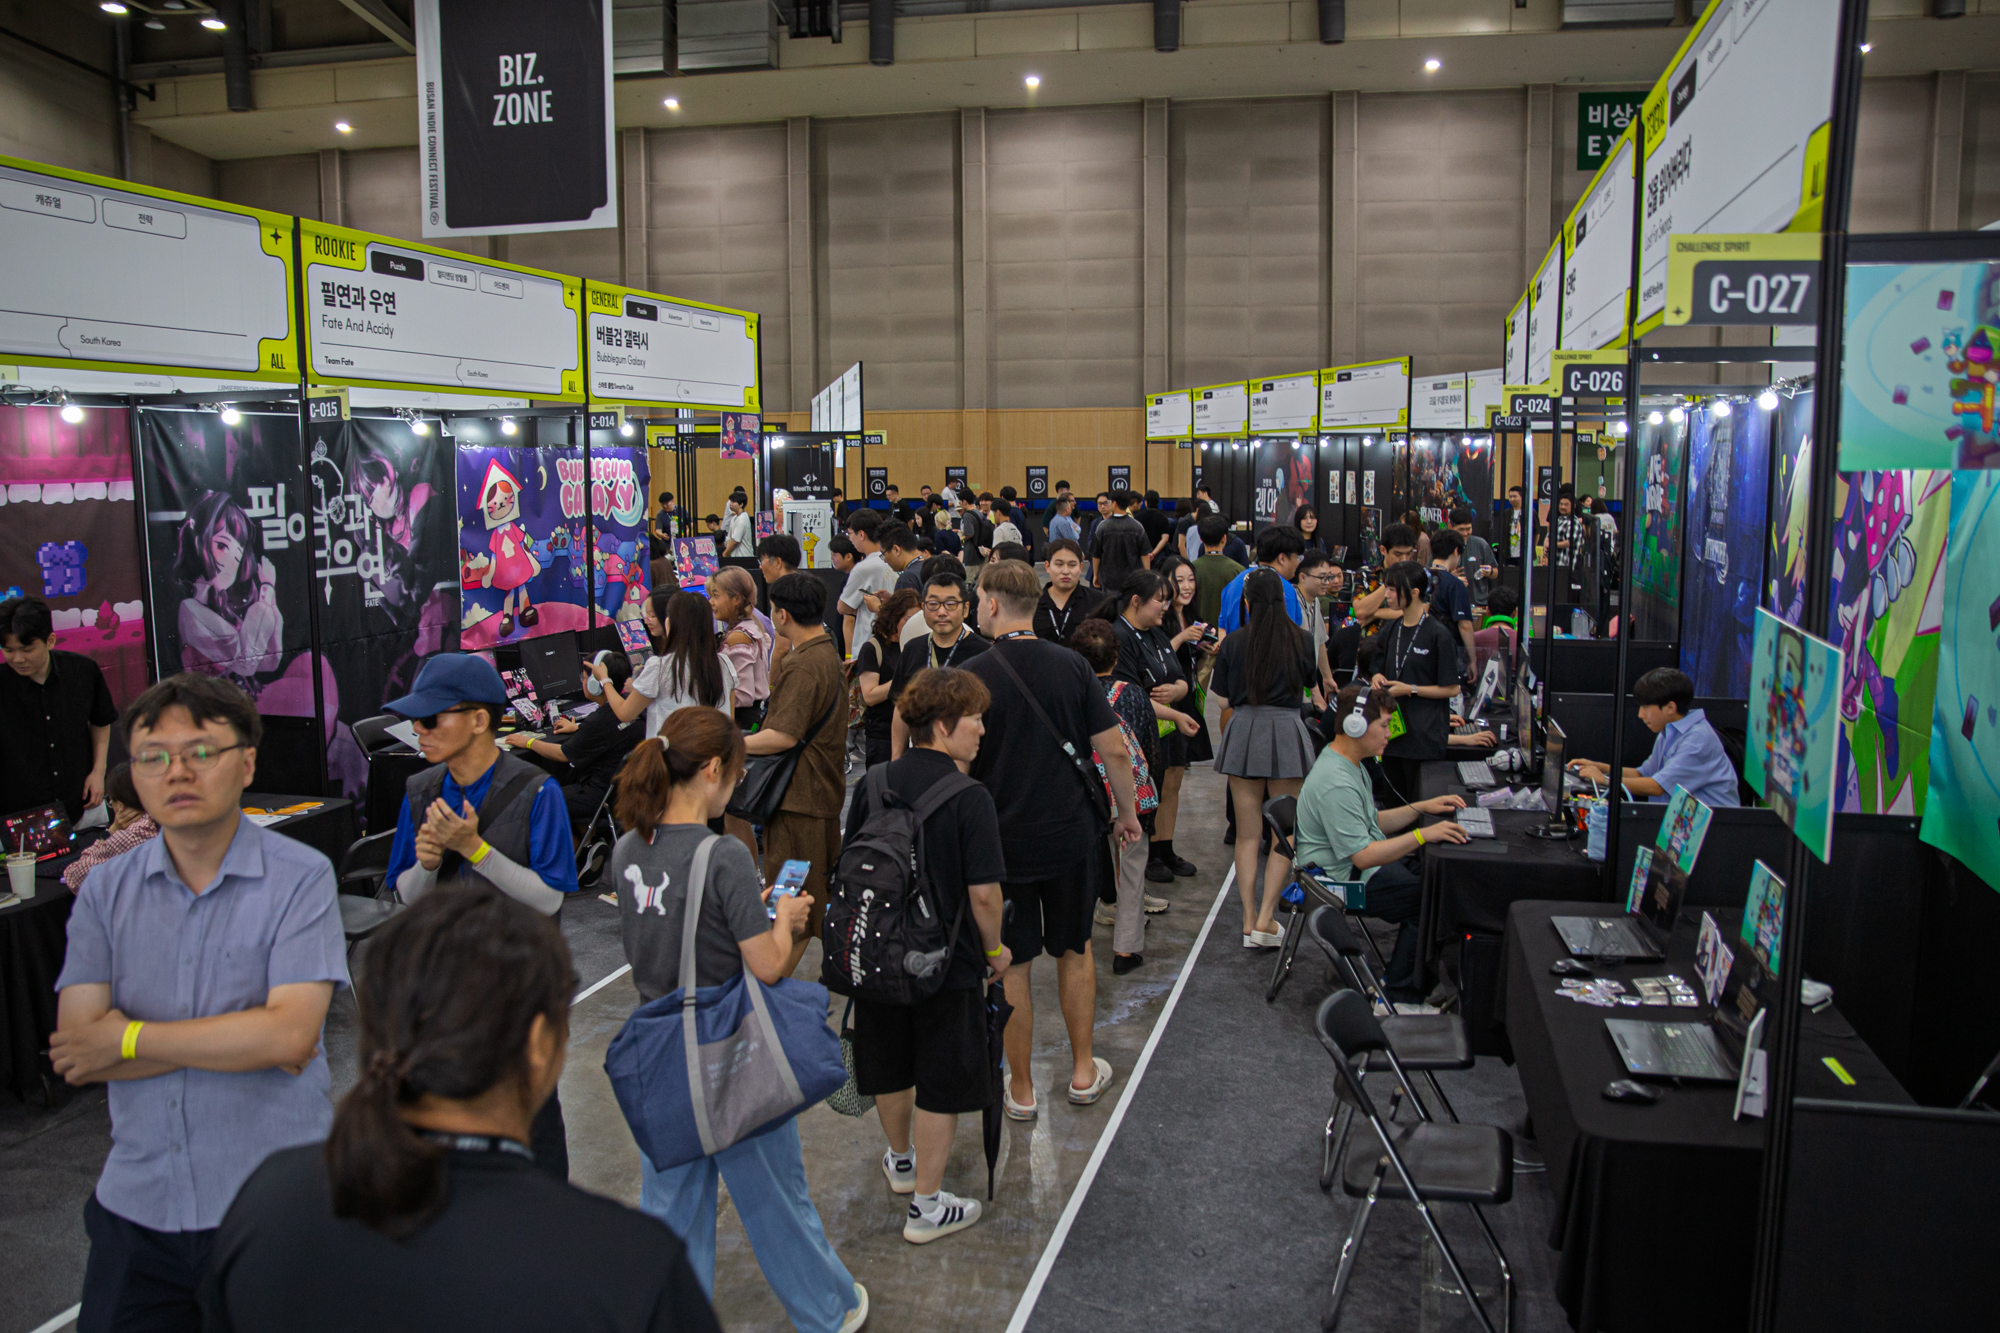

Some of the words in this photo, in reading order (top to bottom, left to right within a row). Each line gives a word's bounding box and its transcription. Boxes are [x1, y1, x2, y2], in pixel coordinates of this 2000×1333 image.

[499, 53, 544, 87] BIZ.
[426, 82, 435, 110] BUSAN
[493, 90, 553, 126] ZONE
[1588, 103, 1642, 128] 비상
[427, 111, 436, 134] INDIE
[428, 136, 438, 172] CONNECT
[429, 174, 439, 210] FESTIVAL
[35, 193, 61, 209] 캐쥬얼
[138, 213, 153, 226] 전략
[315, 235, 356, 261] ROOKIE
[1676, 241, 1722, 253] CHALLENGE
[1723, 240, 1751, 253] SPIRIT
[389, 260, 406, 272] Puzzle
[320, 281, 366, 312] 필연과
[368, 289, 397, 316] 우연
[592, 290, 619, 309] GENERAL
[1709, 273, 1811, 314] C-027
[322, 314, 343, 331] Fate
[345, 316, 364, 333] And
[366, 318, 394, 339] Accidy
[80, 335, 100, 346] South
[101, 337, 121, 347] Korea
[596, 326, 622, 347] 버블검
[624, 329, 649, 351] 갤럭시
[271, 353, 286, 370] ALL
[324, 356, 340, 365] Team
[341, 357, 354, 366] Fate
[597, 351, 627, 366] Bubblegum
[627, 354, 646, 368] Galaxy
[1554, 353, 1577, 361] CHALLENGE
[568, 380, 577, 393] ALL
[1570, 370, 1623, 392] C-026
[309, 401, 337, 418] C-015
[1515, 398, 1550, 413] C-024
[590, 415, 615, 428] C-014
[1494, 414, 1522, 426] C-023
[658, 437, 675, 445] C-004
[846, 440, 860, 448] C-012
[865, 436, 880, 444] C-013
[1577, 434, 1592, 443] C-031
[557, 458, 633, 481] BUBLEGUM
[365, 599, 379, 608] FATE
